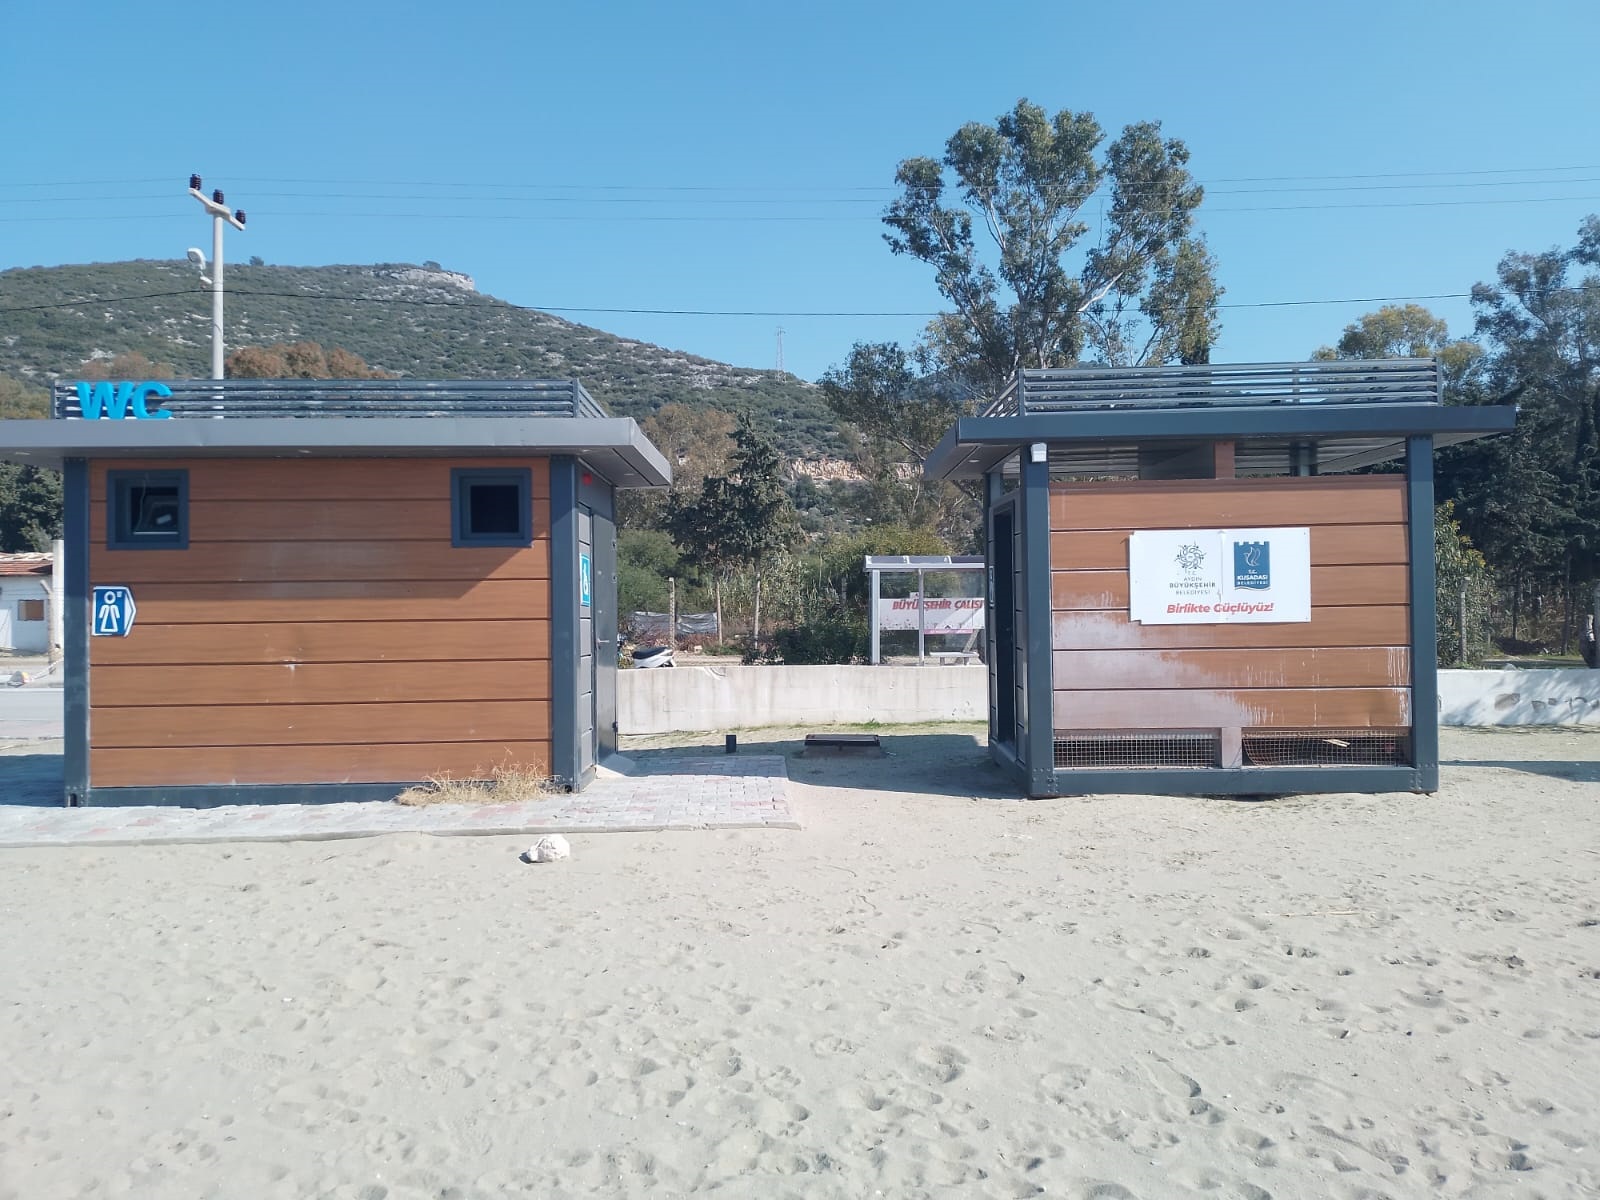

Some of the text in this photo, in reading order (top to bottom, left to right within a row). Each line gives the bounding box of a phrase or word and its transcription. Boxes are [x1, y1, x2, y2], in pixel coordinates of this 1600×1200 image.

[76, 381, 172, 420] WC
[892, 599, 952, 611] BÜYÜŞEHİR
[1167, 602, 1274, 615] Birlikte Güçlüyüz!
